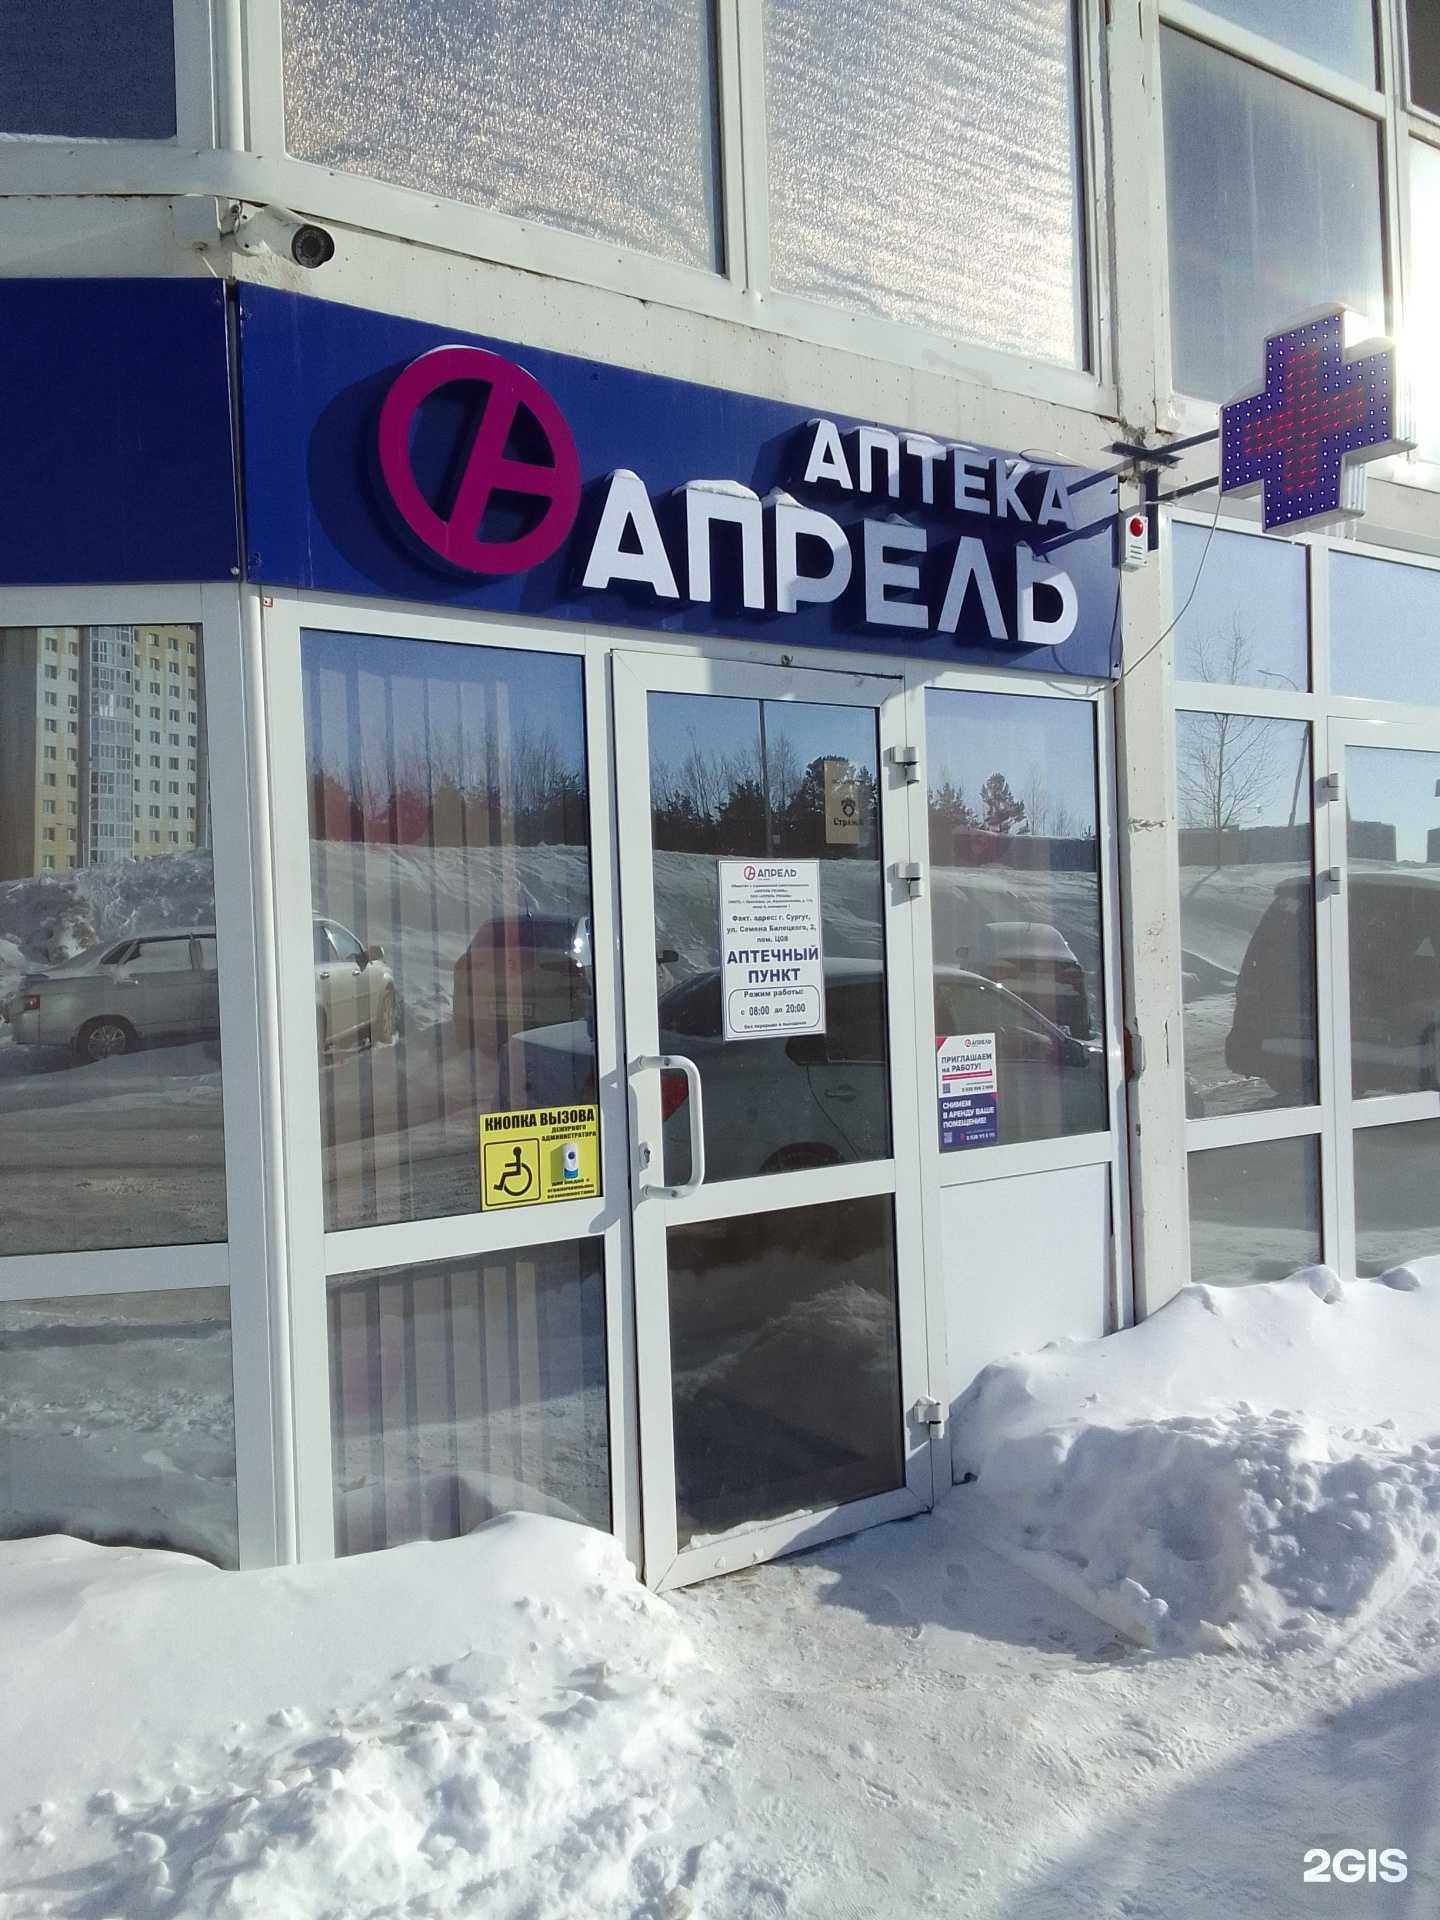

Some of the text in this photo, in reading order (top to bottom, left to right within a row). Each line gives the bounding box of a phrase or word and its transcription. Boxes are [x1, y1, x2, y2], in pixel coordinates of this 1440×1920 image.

[804, 419, 1075, 530] АПТЕКА
[582, 468, 1078, 646] АПРЕЛЬ
[757, 868, 797, 878] АПРЕЛЬ
[786, 913, 811, 922] Сургут,
[726, 926, 738, 934] ул.
[726, 945, 819, 964] АПТЕЧНЫЙ
[748, 967, 801, 984] ПУНКТ
[743, 988, 804, 998] Режим работы:
[748, 1005, 770, 1016] 08:00
[785, 1003, 806, 1014] 20:00
[941, 1052, 993, 1064] ПРИГЛАШАЕМ
[484, 1108, 595, 1132] КНОПКА ВЫЗОВА
[948, 1109, 975, 1119] АРЕНДУ
